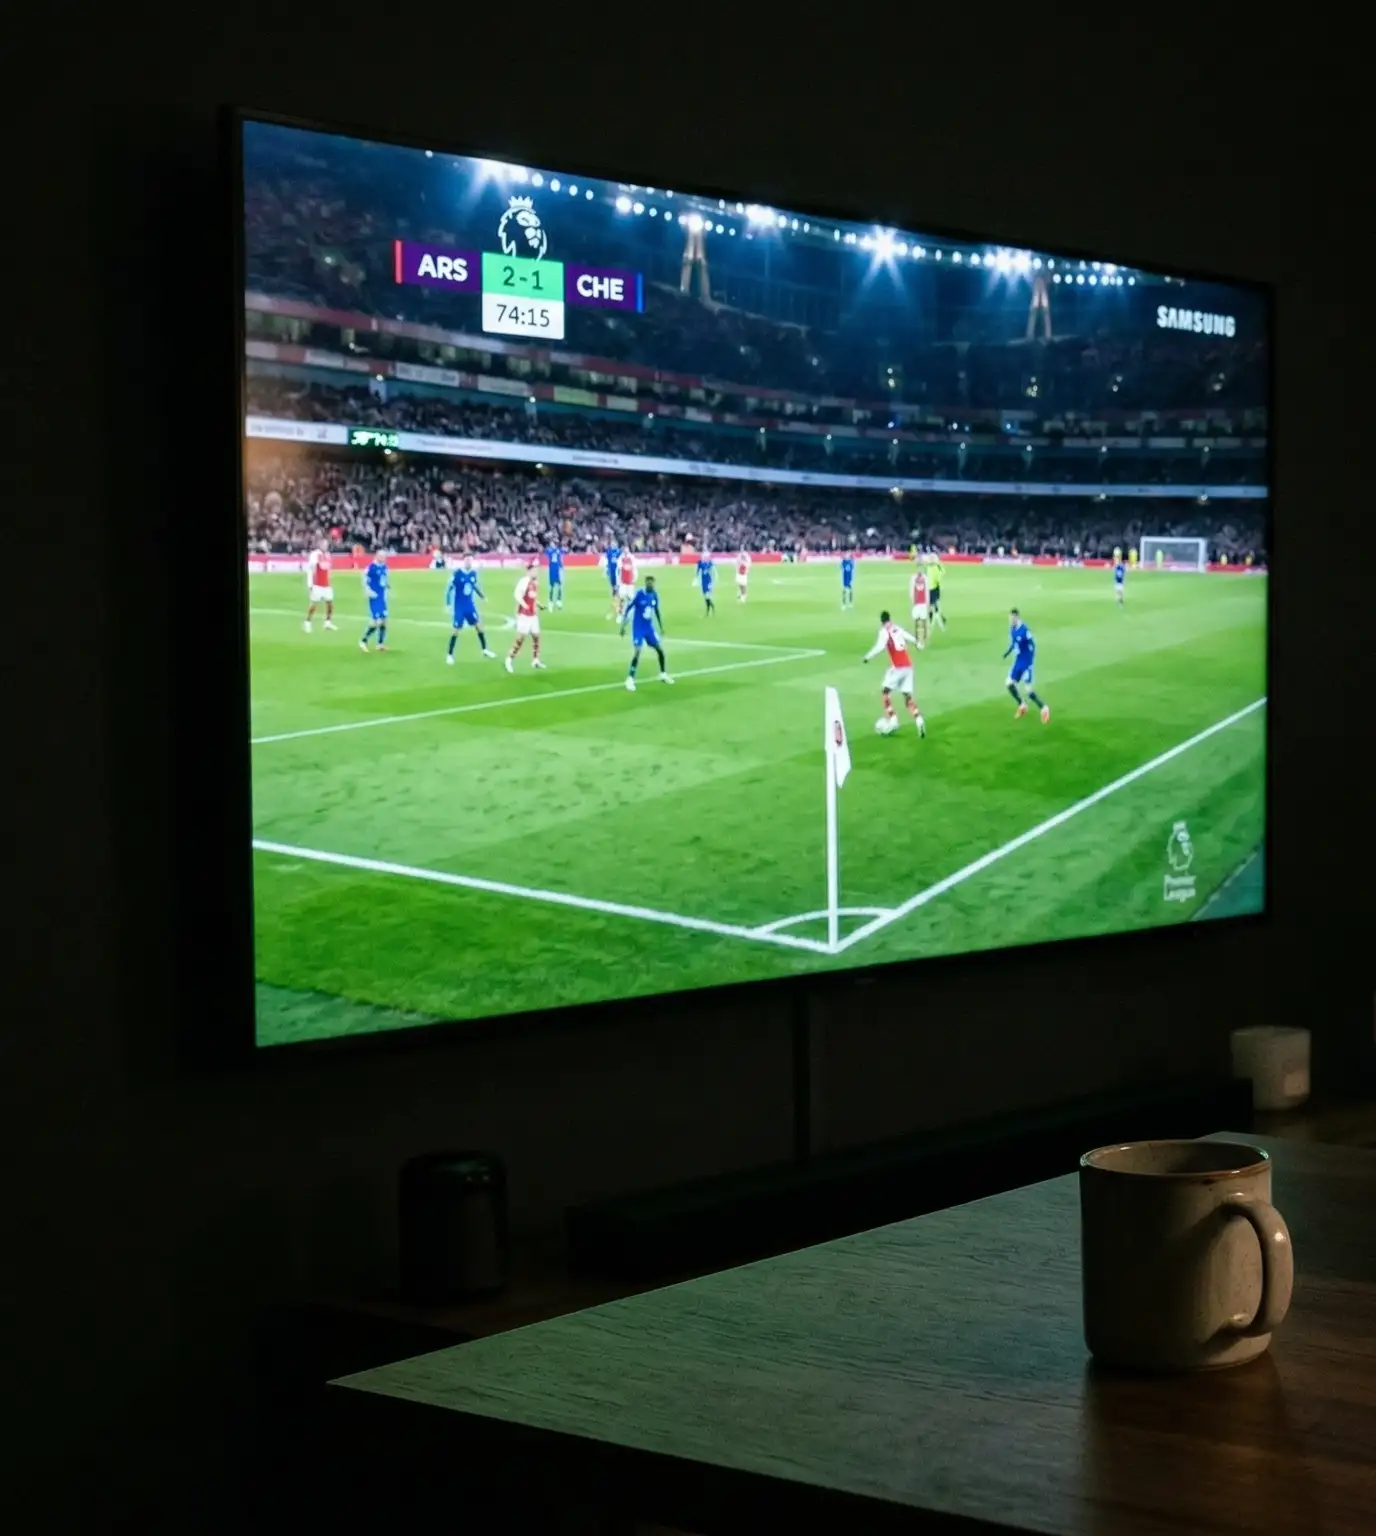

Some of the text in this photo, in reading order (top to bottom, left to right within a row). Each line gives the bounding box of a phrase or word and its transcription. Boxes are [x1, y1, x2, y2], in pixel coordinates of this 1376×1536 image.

[418, 254, 467, 281] ARS
[577, 275, 624, 301] CHE
[497, 304, 549, 327] 74:15
[1157, 306, 1235, 337] SAMSUNG
